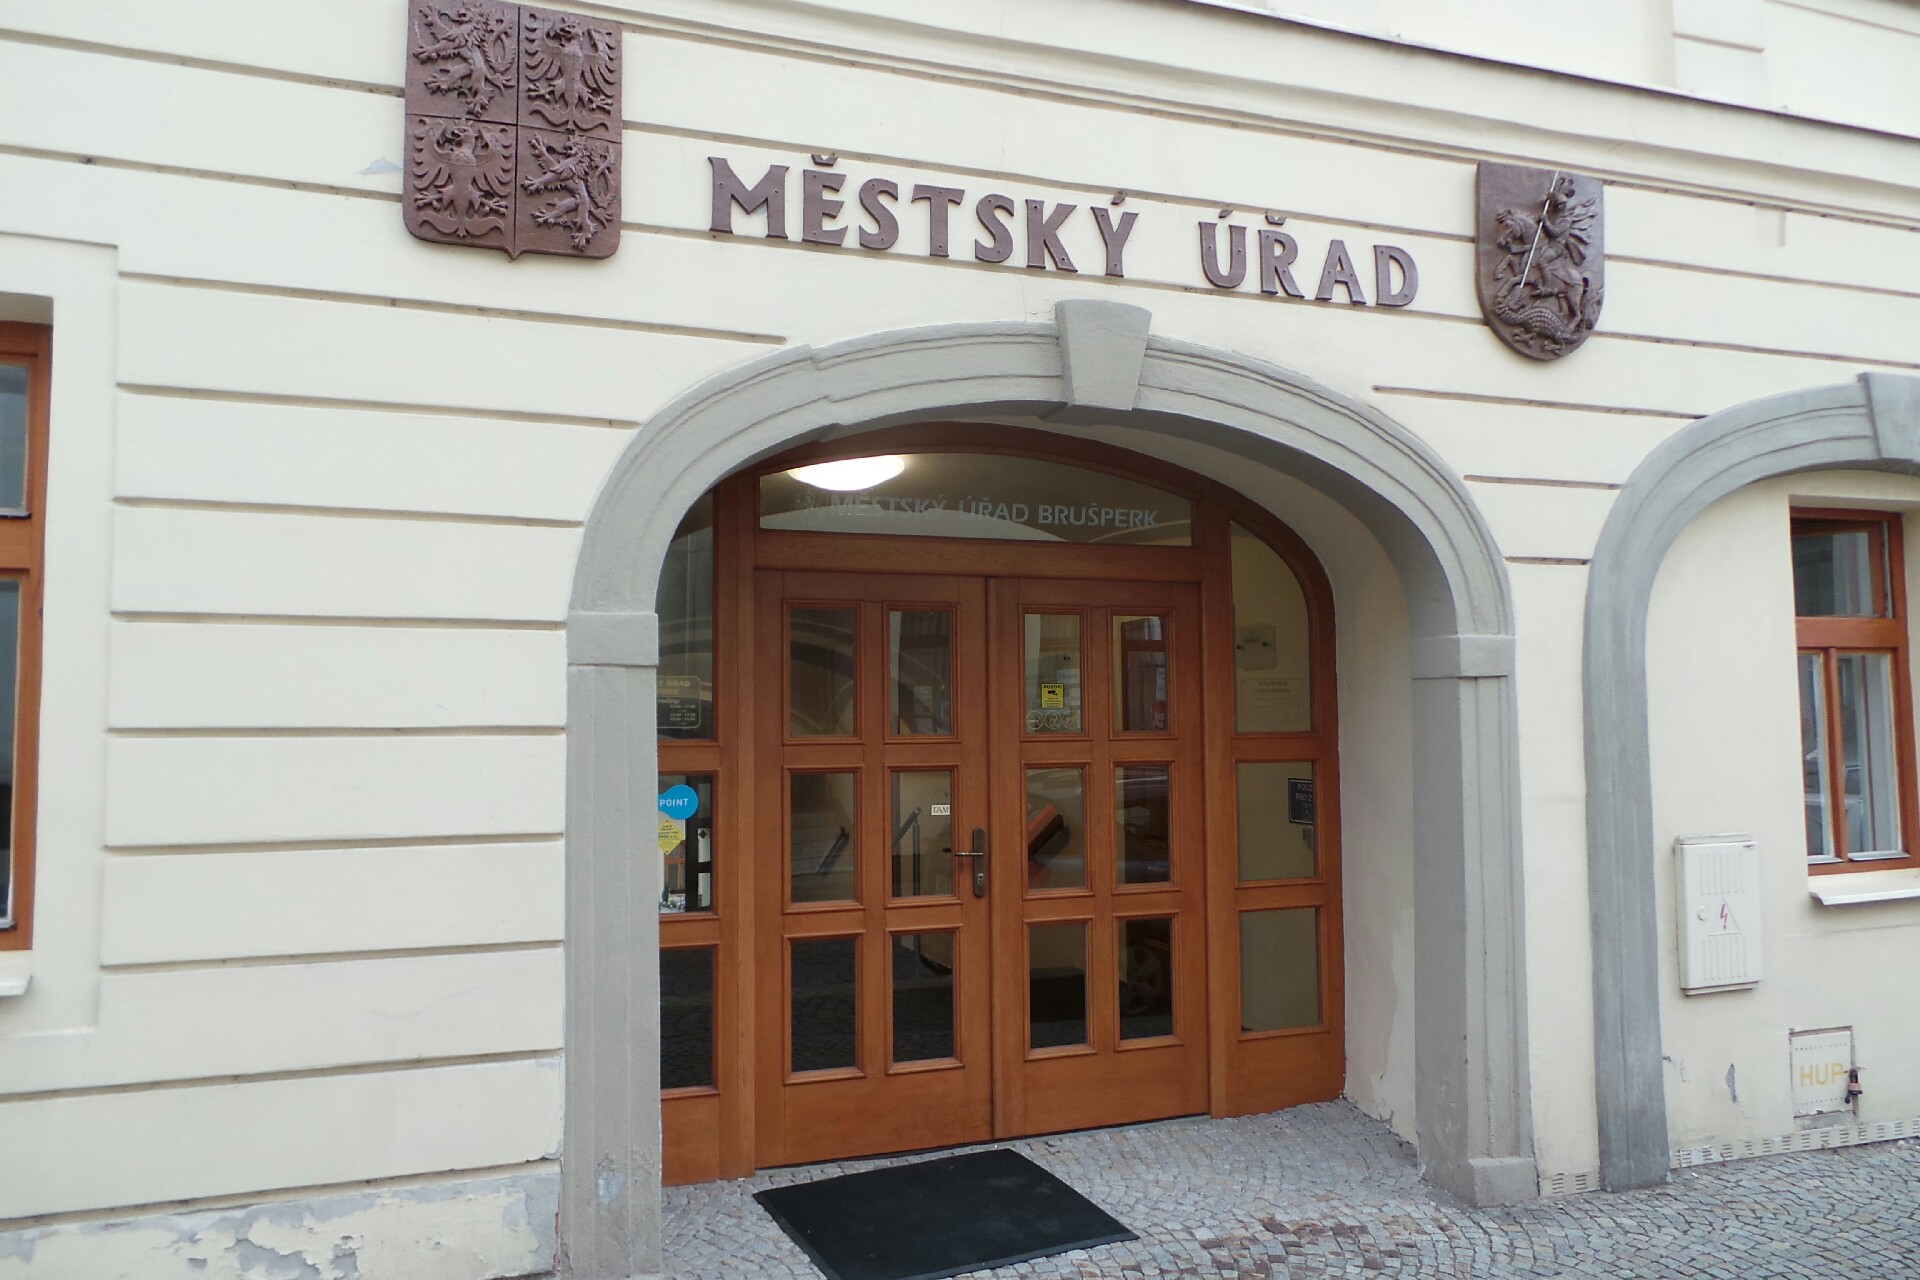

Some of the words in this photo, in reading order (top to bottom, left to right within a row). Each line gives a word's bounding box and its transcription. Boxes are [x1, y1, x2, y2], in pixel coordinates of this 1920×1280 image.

[707, 153, 1140, 278] MĚSTSKÝ
[1198, 208, 1419, 307] ÚŘAD
[958, 495, 1029, 523] ÚŘAD
[1038, 501, 1159, 530] BRUŠPERK
[659, 798, 689, 807] POINT
[932, 806, 949, 814] TAM
[1800, 1061, 1845, 1088] HUP
